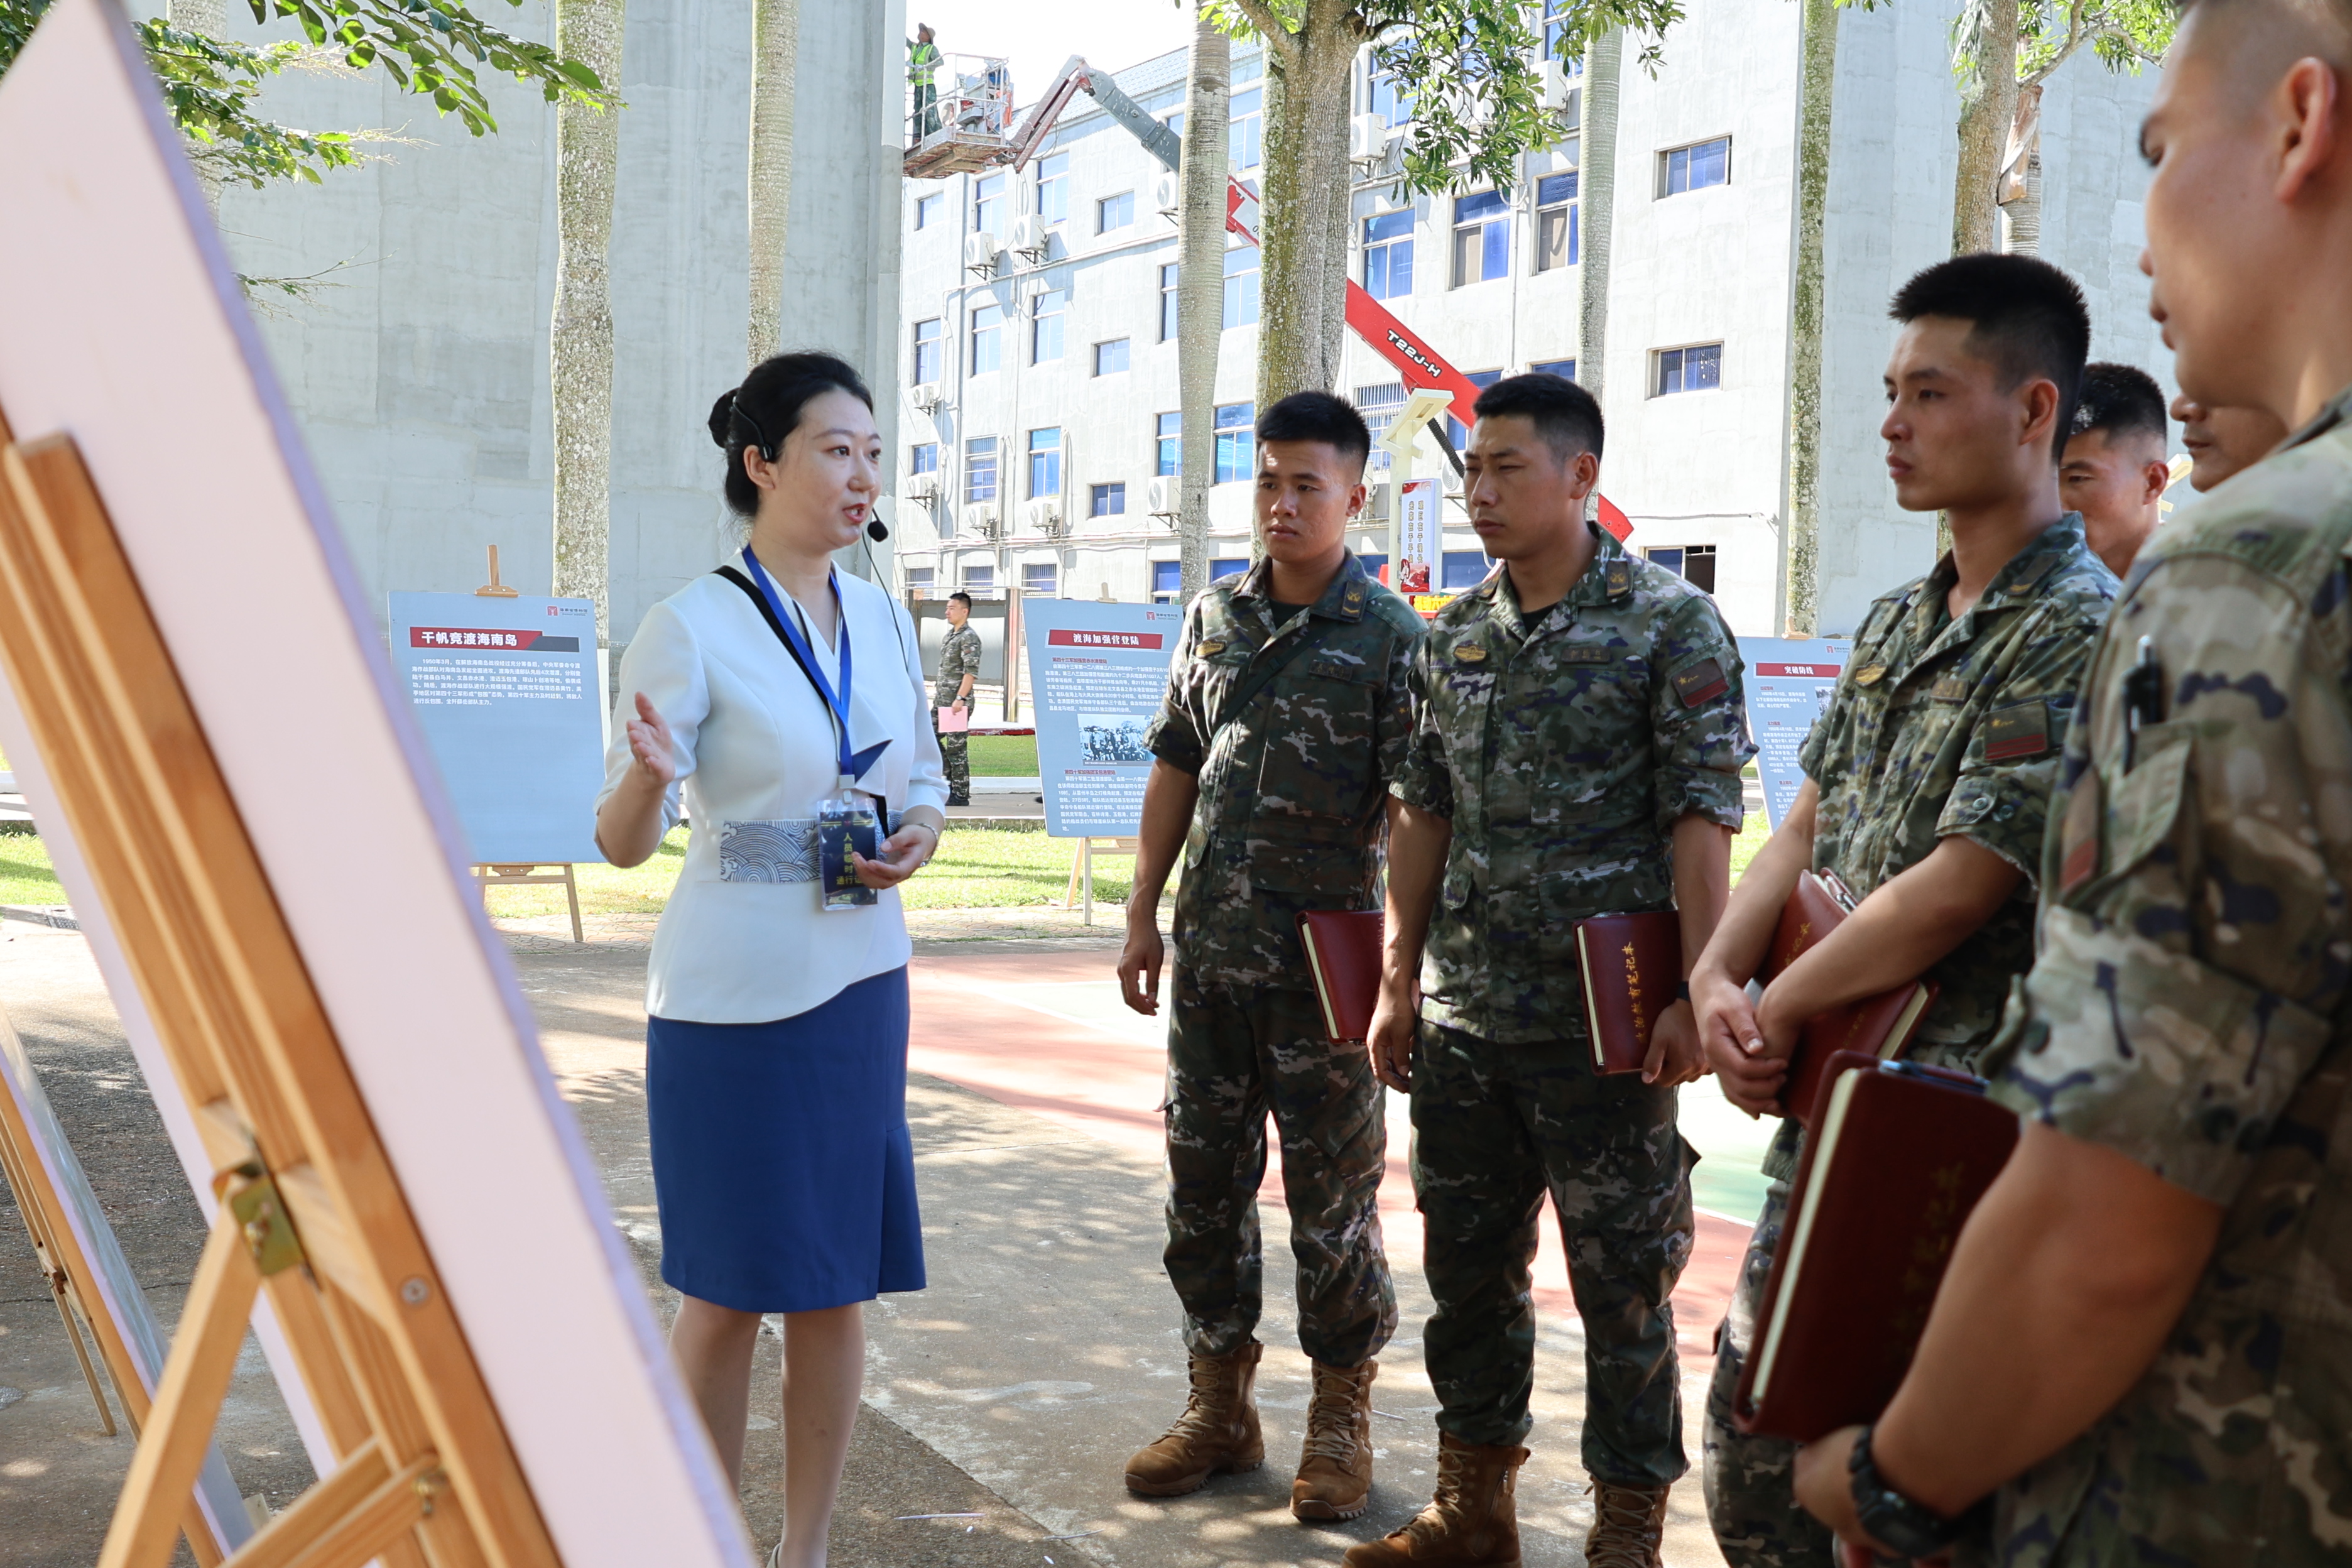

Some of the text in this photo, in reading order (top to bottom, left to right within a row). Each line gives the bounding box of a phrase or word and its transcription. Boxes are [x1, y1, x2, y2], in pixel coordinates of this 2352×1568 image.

[1387, 330, 1442, 378] T22J-H
[422, 631, 518, 646] 千帆竞渡海南岛
[1073, 633, 1140, 646] 渡海加强营登陆
[1784, 666, 1814, 675] 突破防线
